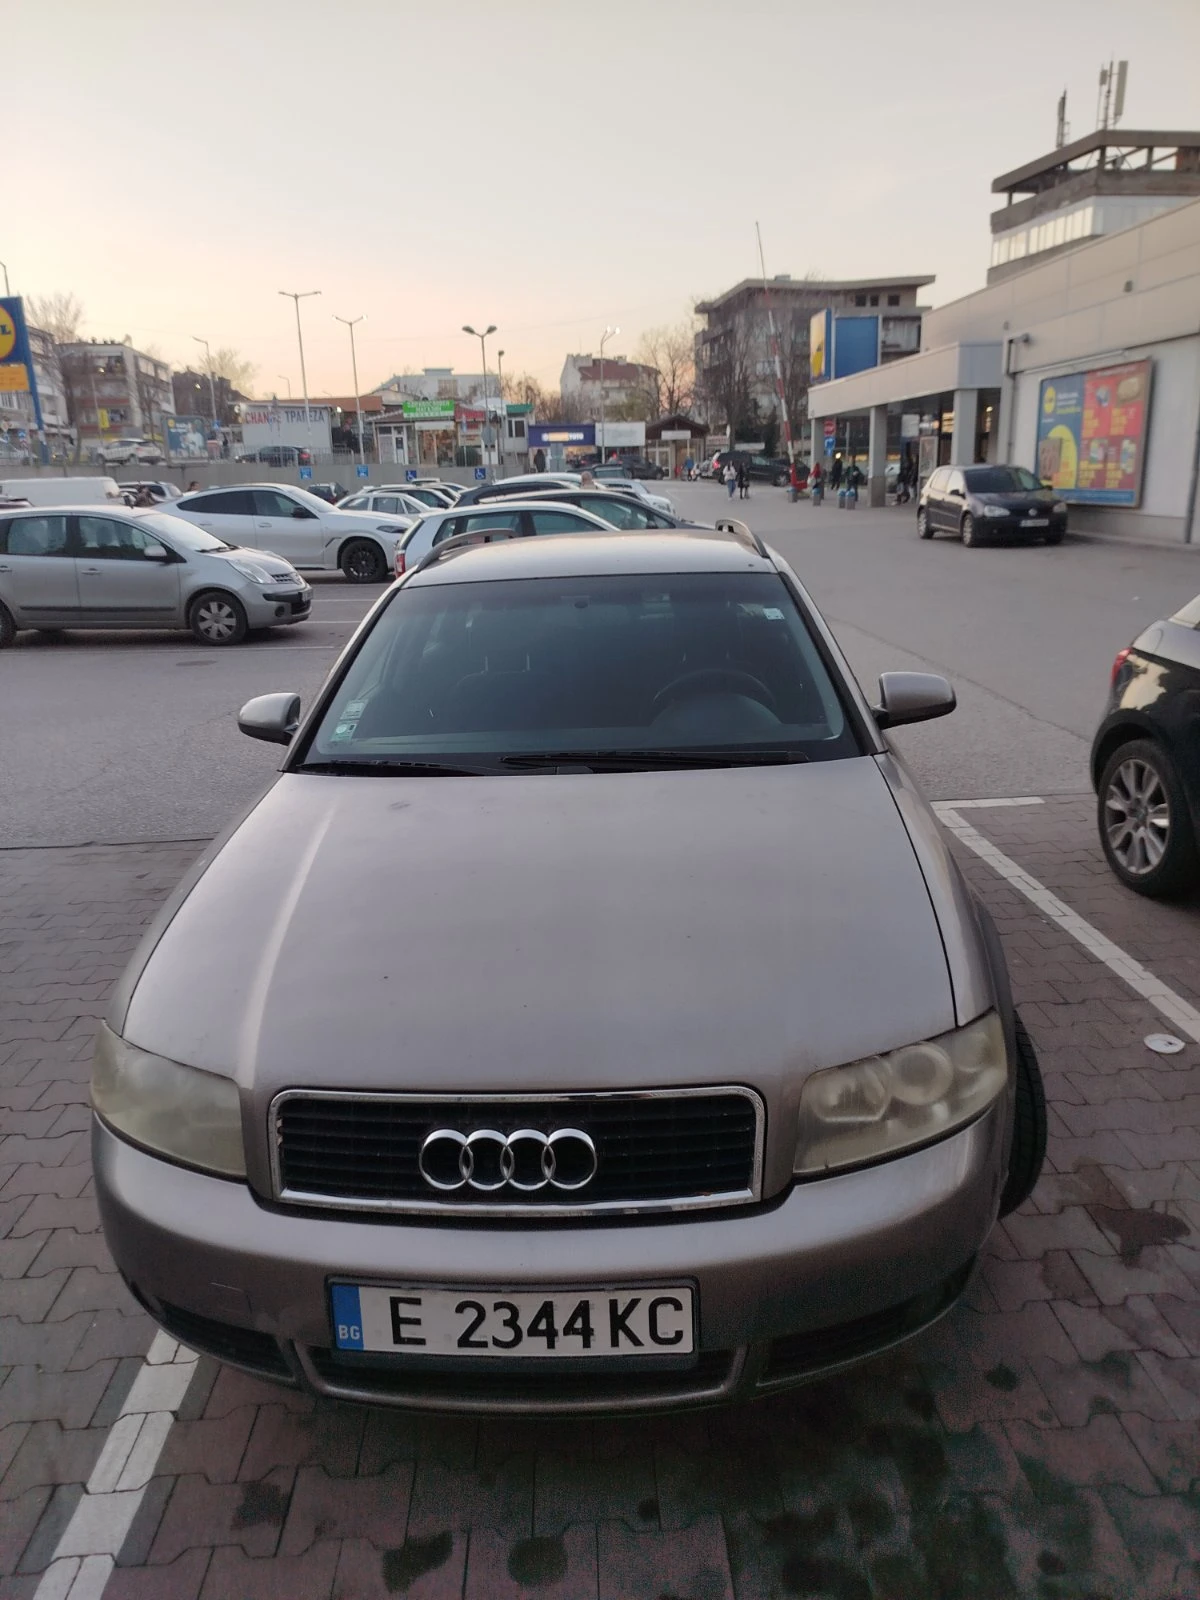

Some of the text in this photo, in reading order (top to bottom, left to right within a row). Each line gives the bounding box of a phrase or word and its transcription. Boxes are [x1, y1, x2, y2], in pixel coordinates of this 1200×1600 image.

[245, 411, 282, 424] CHAN
[389, 1296, 684, 1349] E 2344 KC
[338, 1324, 360, 1340] BG
